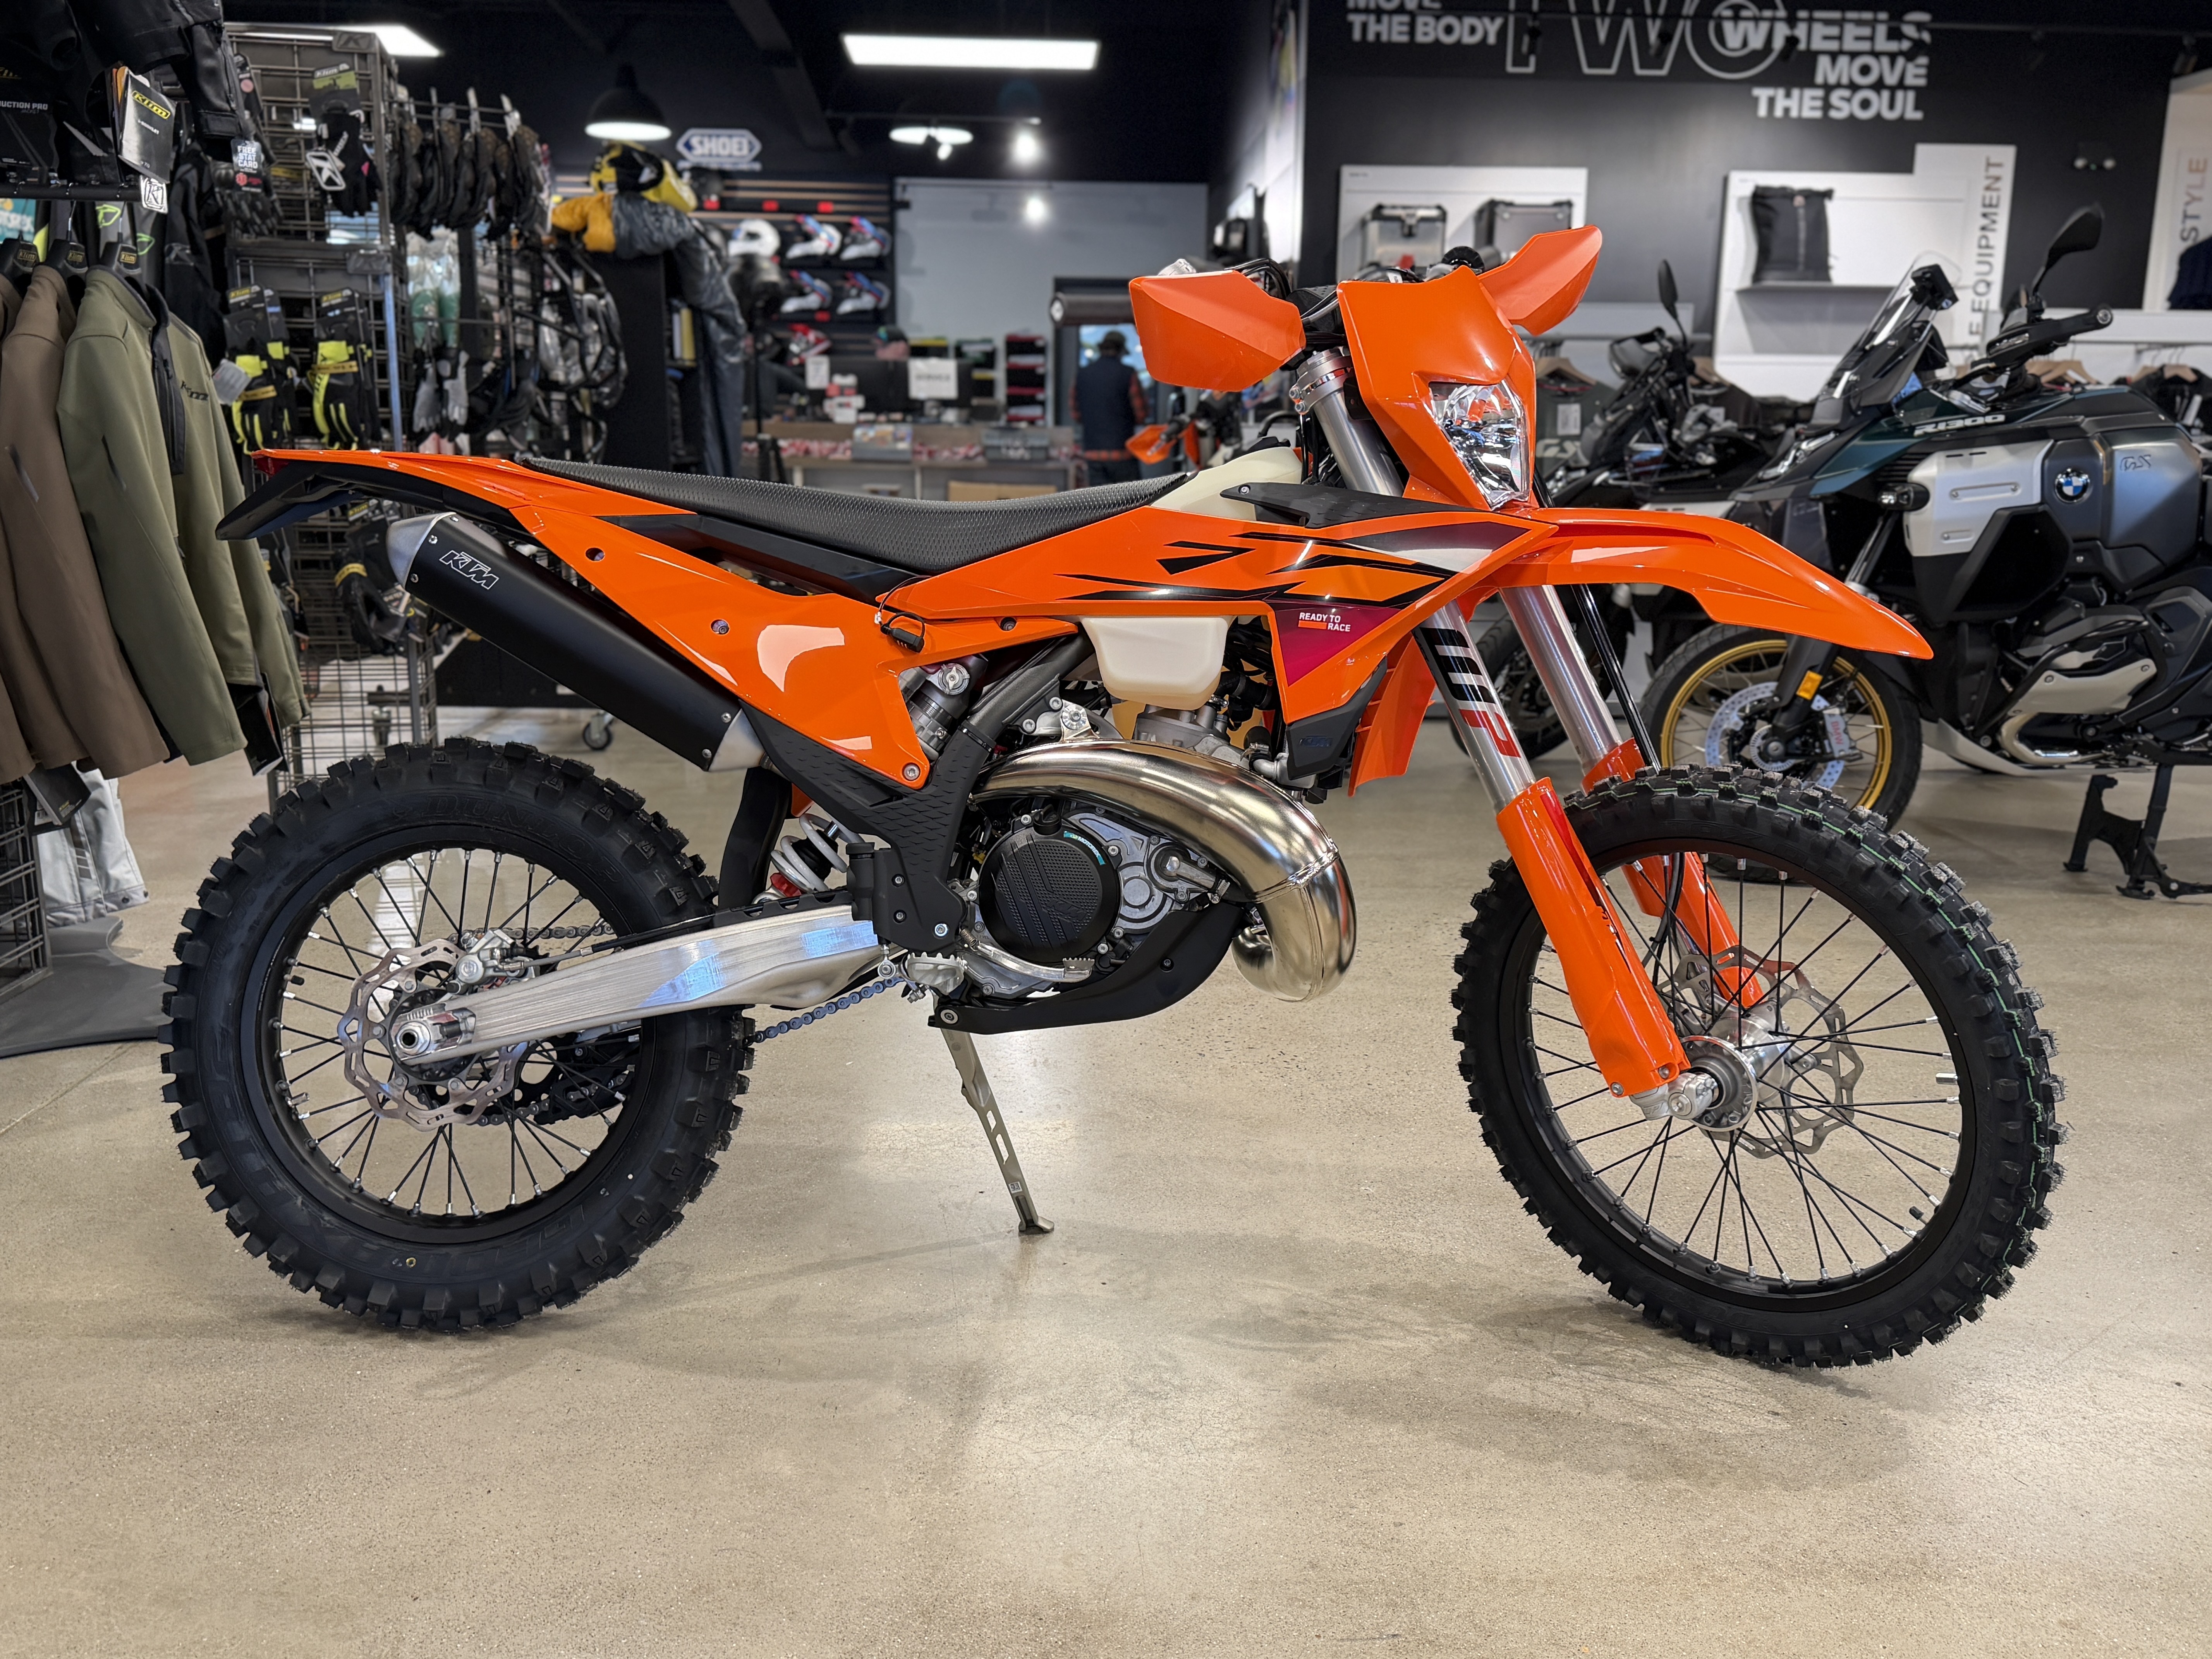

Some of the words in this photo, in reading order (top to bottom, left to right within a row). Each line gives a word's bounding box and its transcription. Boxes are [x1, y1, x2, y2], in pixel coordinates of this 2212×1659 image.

[1348, 15, 1410, 43] THE
[1415, 15, 1506, 45] BODY
[1719, 10, 1932, 52] WHEELS
[1814, 54, 1930, 87] MOVE
[0, 101, 30, 109] UCTION
[1751, 87, 1825, 118] THE
[1828, 88, 1924, 120] SOUL
[237, 146, 256, 154] FREE
[239, 153, 256, 161] STAT
[689, 136, 749, 156] SHOEI
[238, 160, 258, 169] CARD
[2179, 158, 2209, 244] STYLE
[1972, 156, 2004, 314] EQUIPMENT
[439, 550, 500, 590] KTM
[1299, 612, 1328, 622] READY
[1329, 614, 1341, 623] TO
[1328, 623, 1351, 632] RACE
[1831, 721, 1844, 745] BMW
